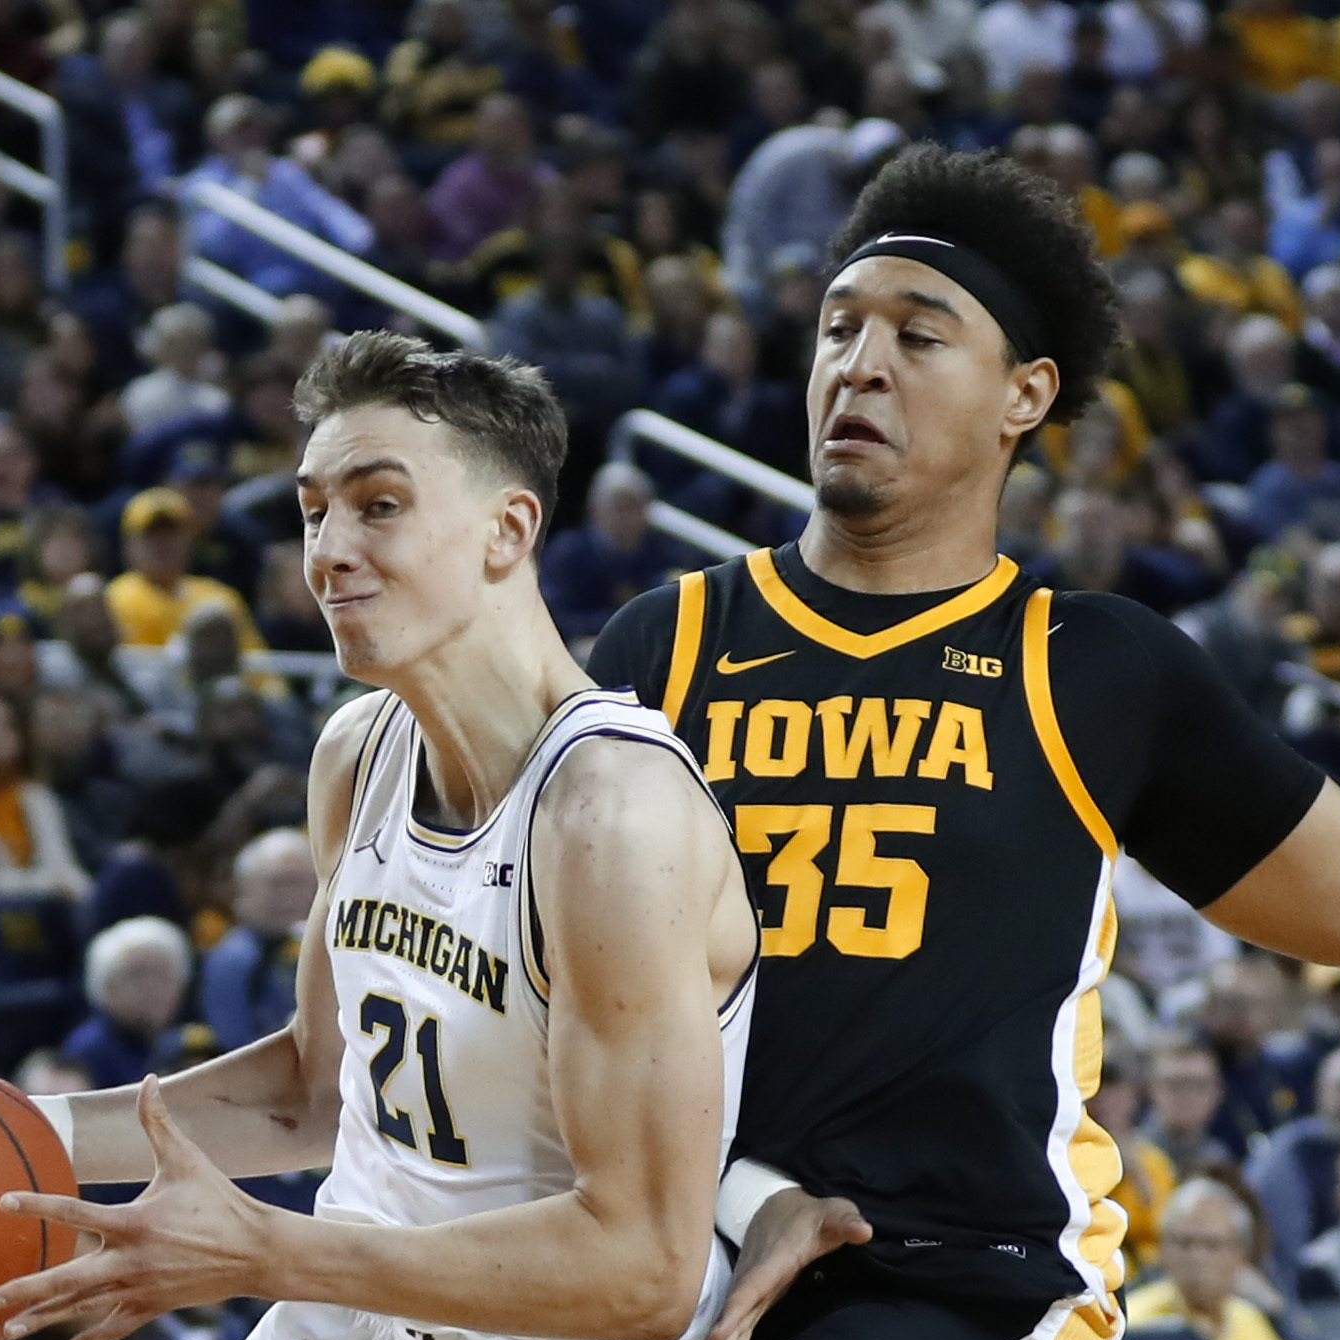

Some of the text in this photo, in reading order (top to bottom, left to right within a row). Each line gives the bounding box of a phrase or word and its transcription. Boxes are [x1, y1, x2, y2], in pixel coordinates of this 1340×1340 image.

[703, 695, 994, 791] IOWA
[734, 803, 937, 960] 35
[333, 897, 509, 1017] MICHIGAN
[359, 989, 471, 1169] 21
